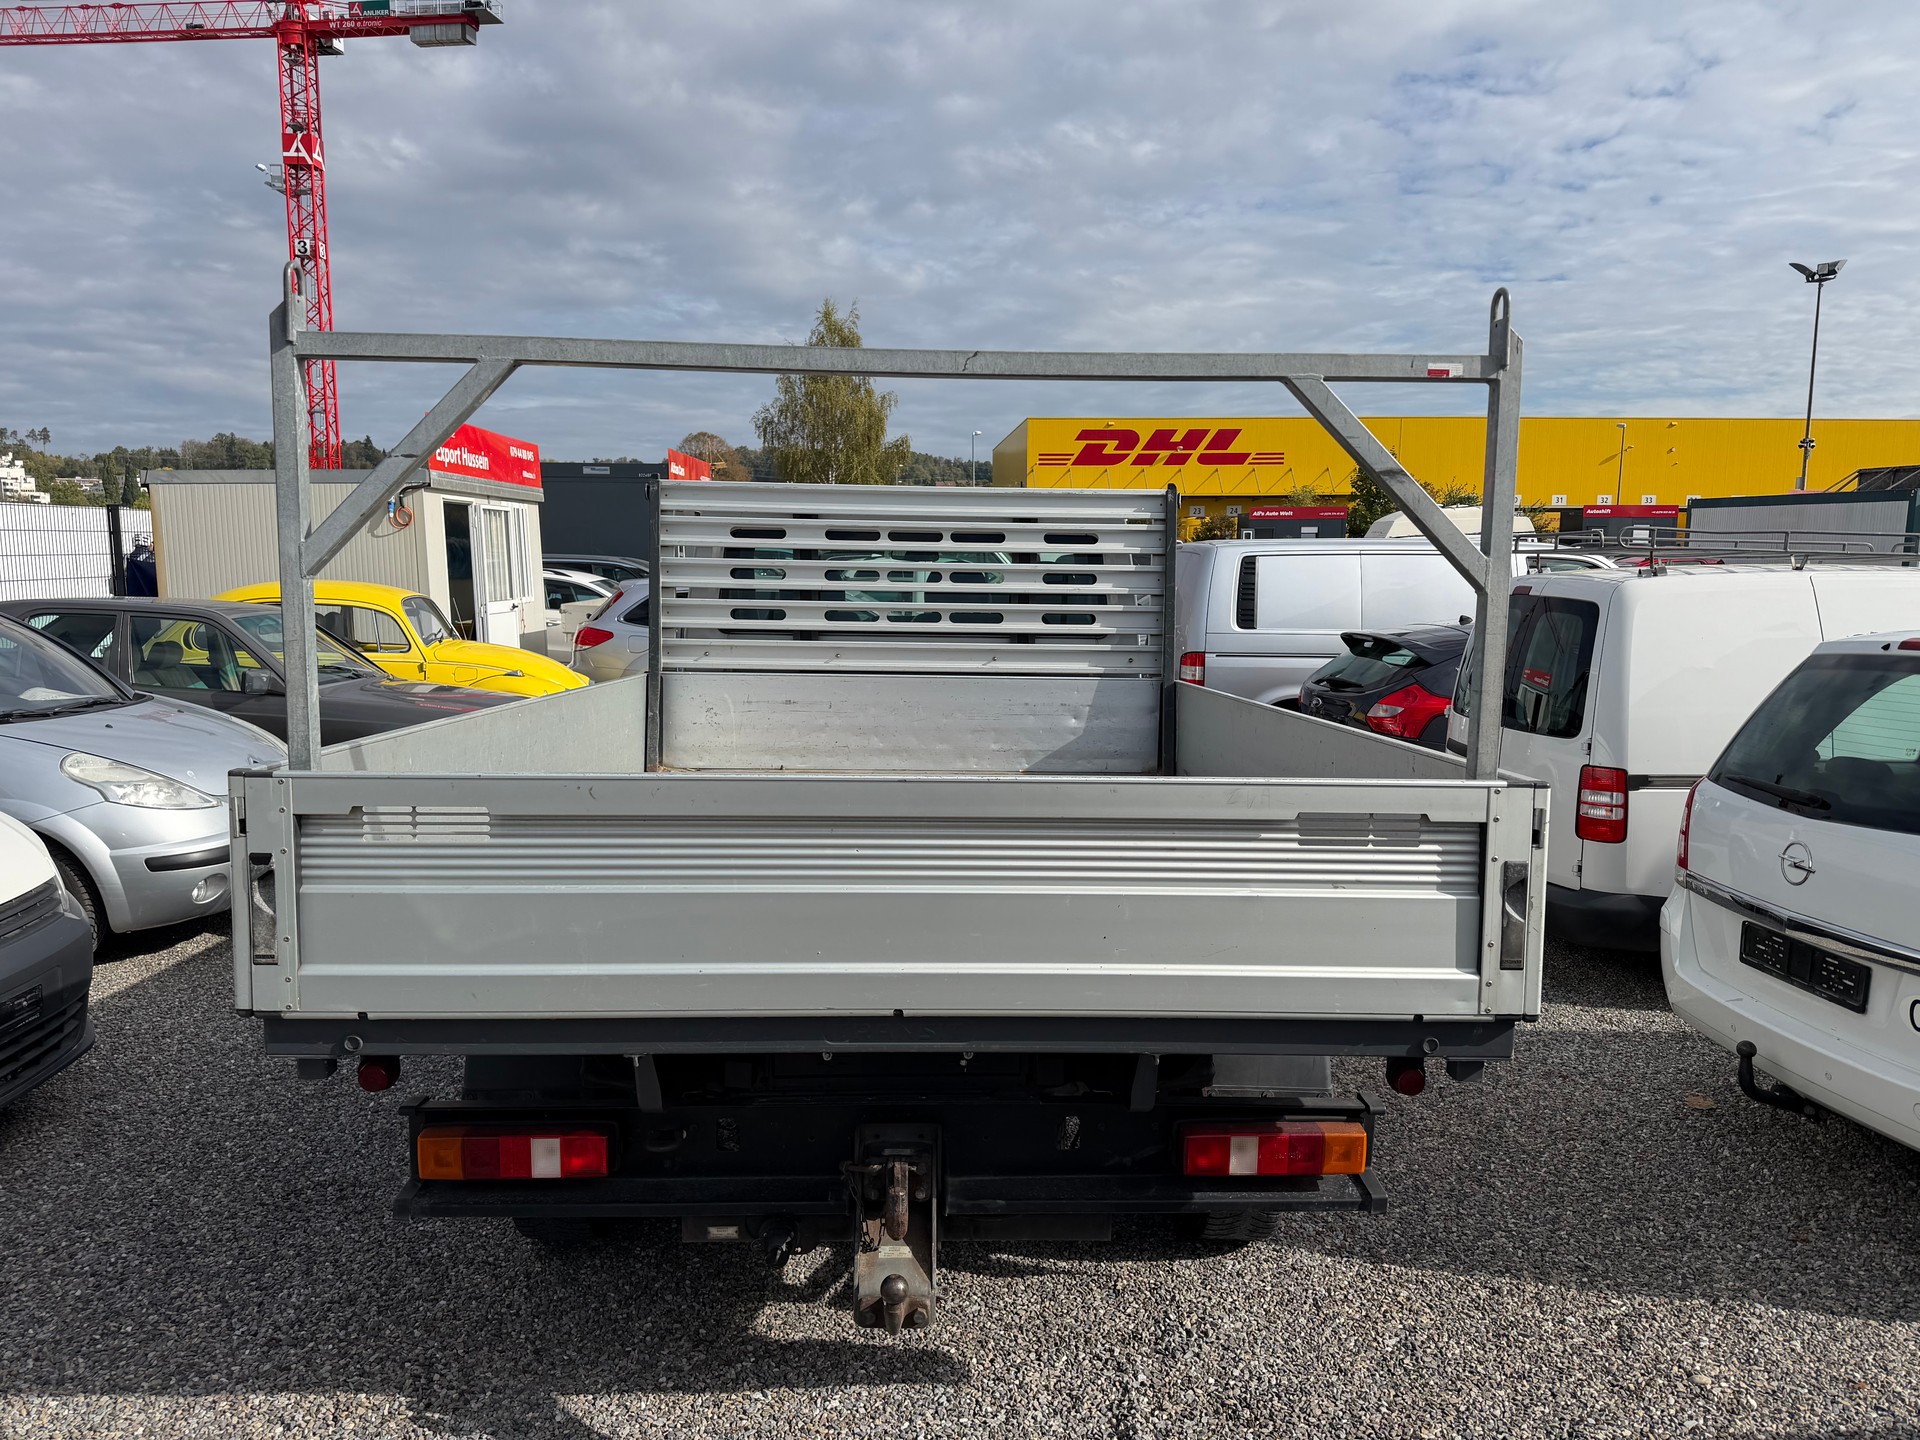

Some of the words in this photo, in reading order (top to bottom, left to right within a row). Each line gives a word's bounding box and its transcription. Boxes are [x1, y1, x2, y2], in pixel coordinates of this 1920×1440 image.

[329, 21, 340, 29] WT
[342, 20, 355, 28] 260
[297, 240, 308, 255] 3
[1070, 428, 1253, 466] DHL
[461, 446, 490, 471] Hussein
[1600, 496, 1609, 504] 32
[1644, 496, 1653, 504] 33
[1193, 507, 1202, 515] 23
[1229, 507, 1238, 515] 24
